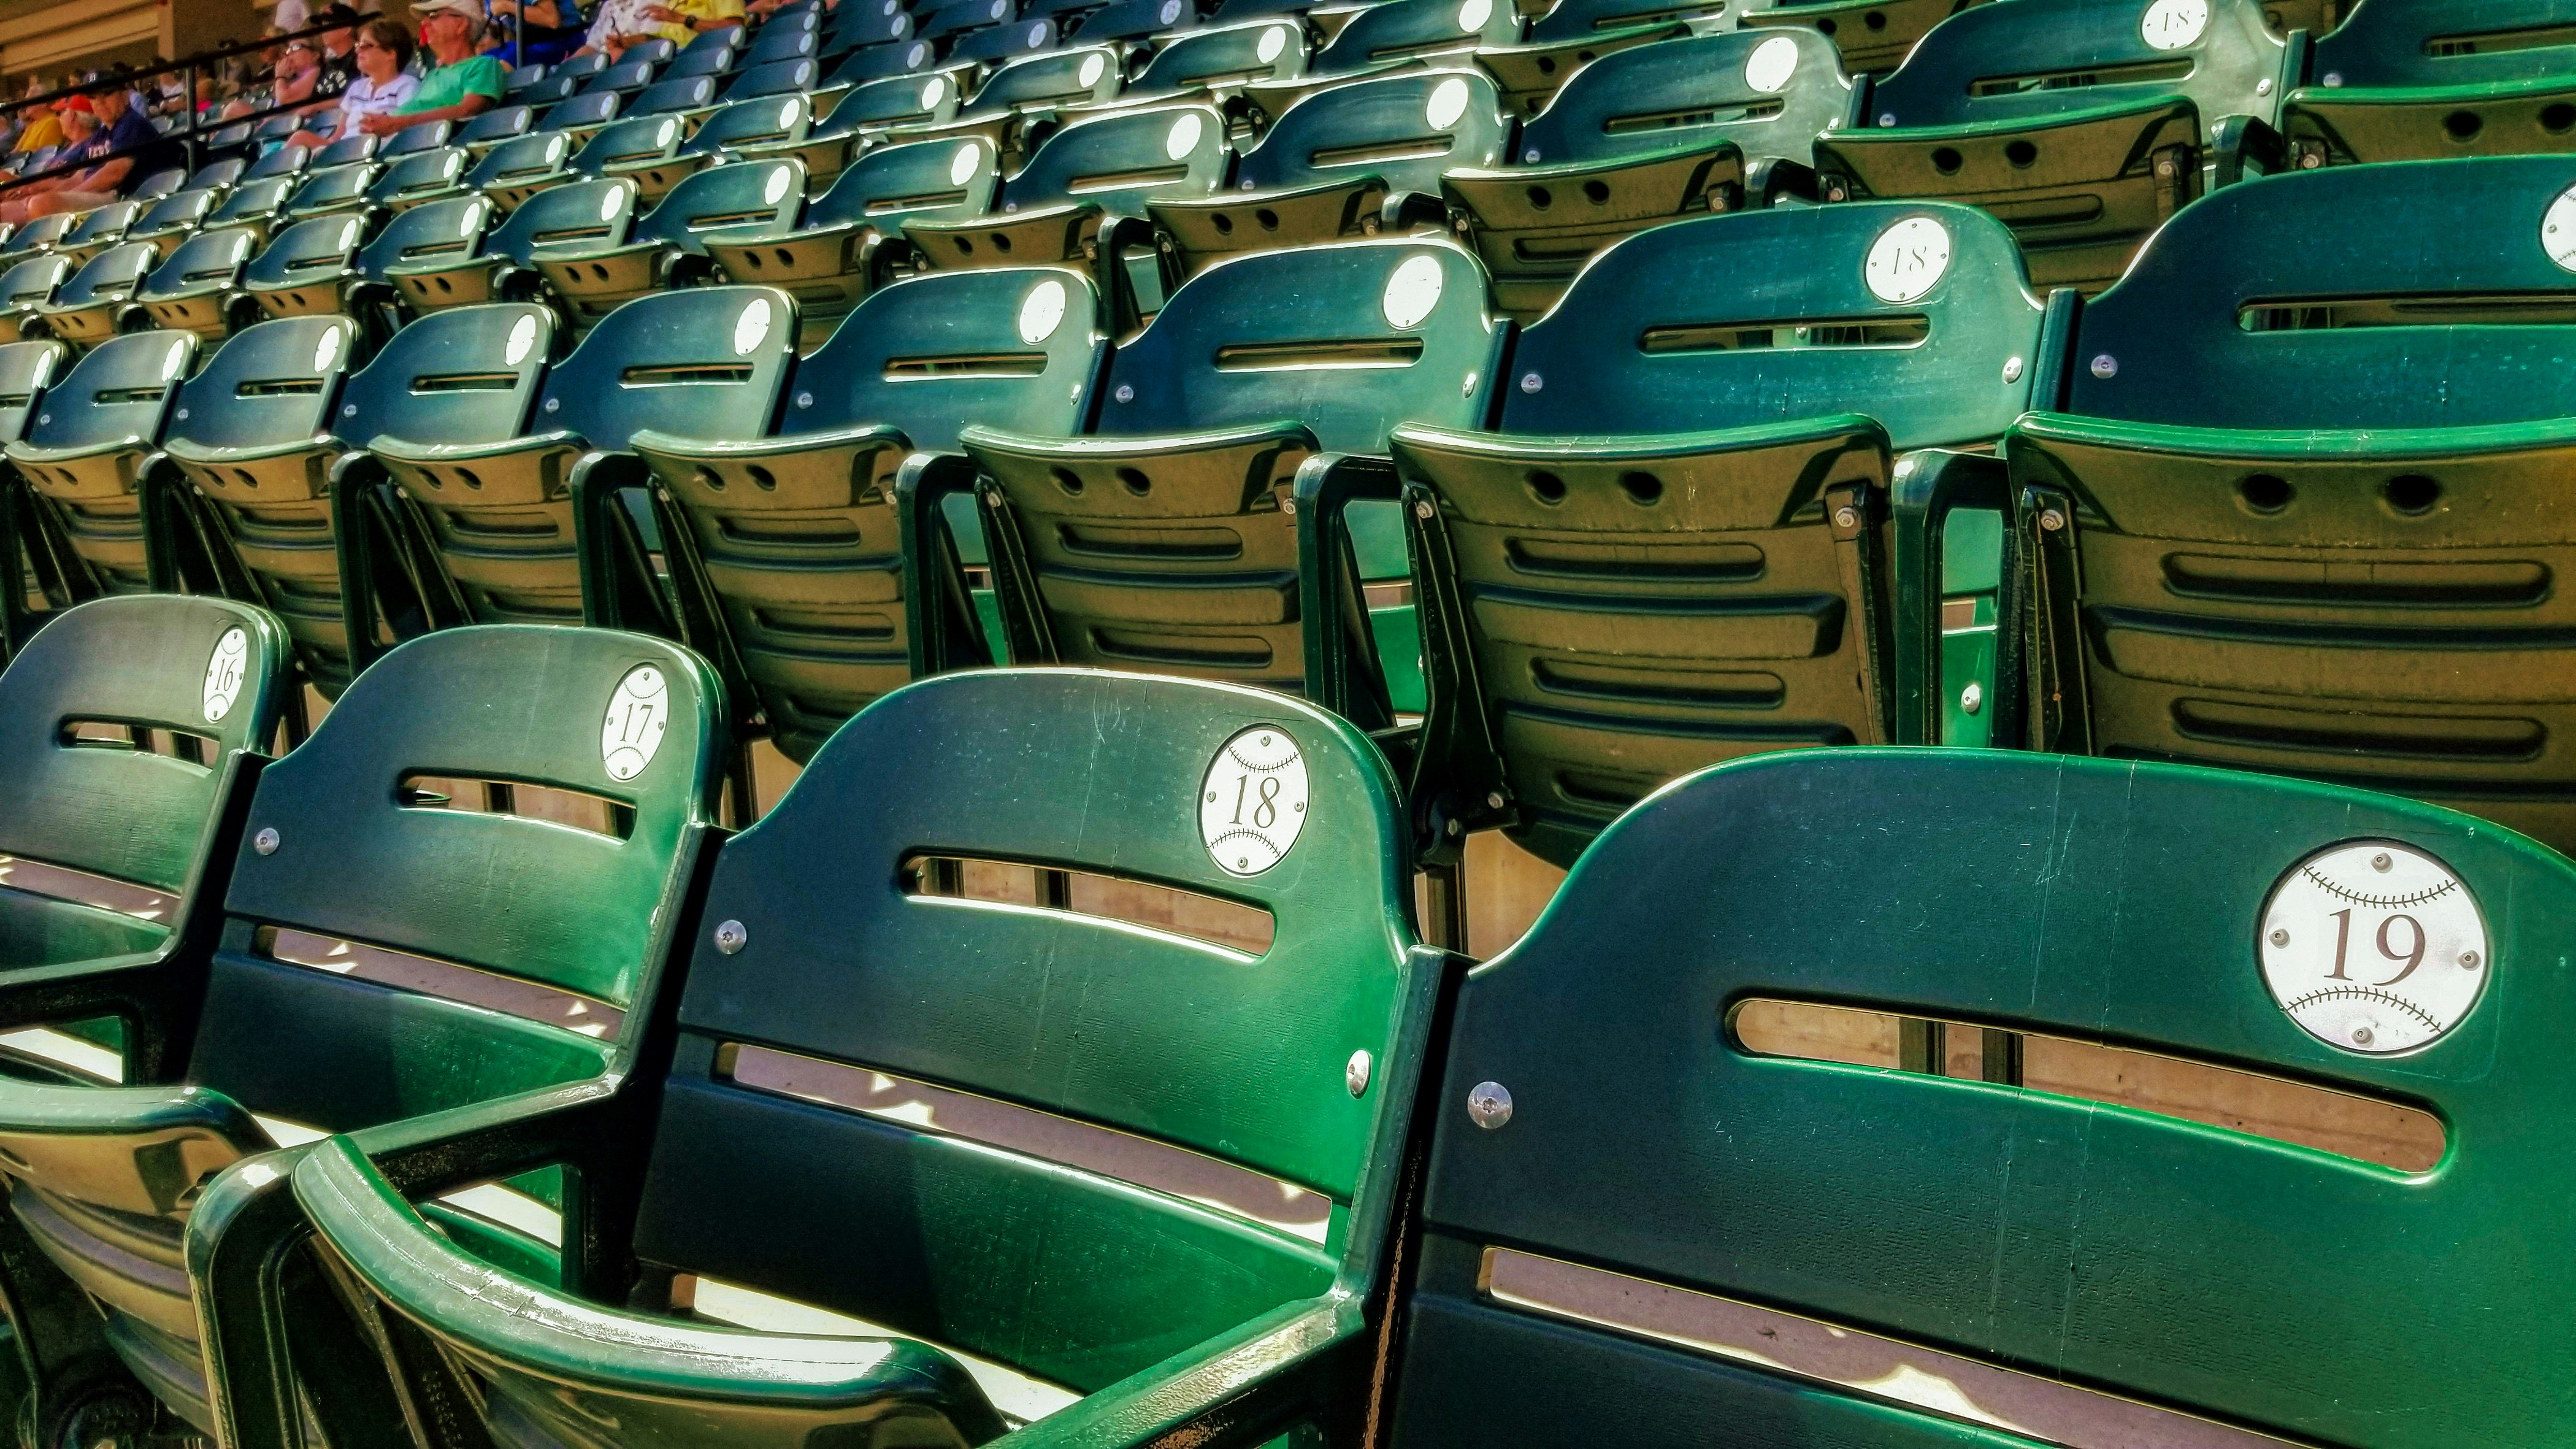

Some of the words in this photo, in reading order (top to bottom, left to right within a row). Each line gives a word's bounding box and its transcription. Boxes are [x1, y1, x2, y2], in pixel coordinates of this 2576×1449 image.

[1893, 245, 1927, 275] 18
[215, 658, 237, 692] 16
[619, 702, 654, 744] 17
[1229, 774, 1281, 829] 18
[2323, 908, 2426, 986] 19
